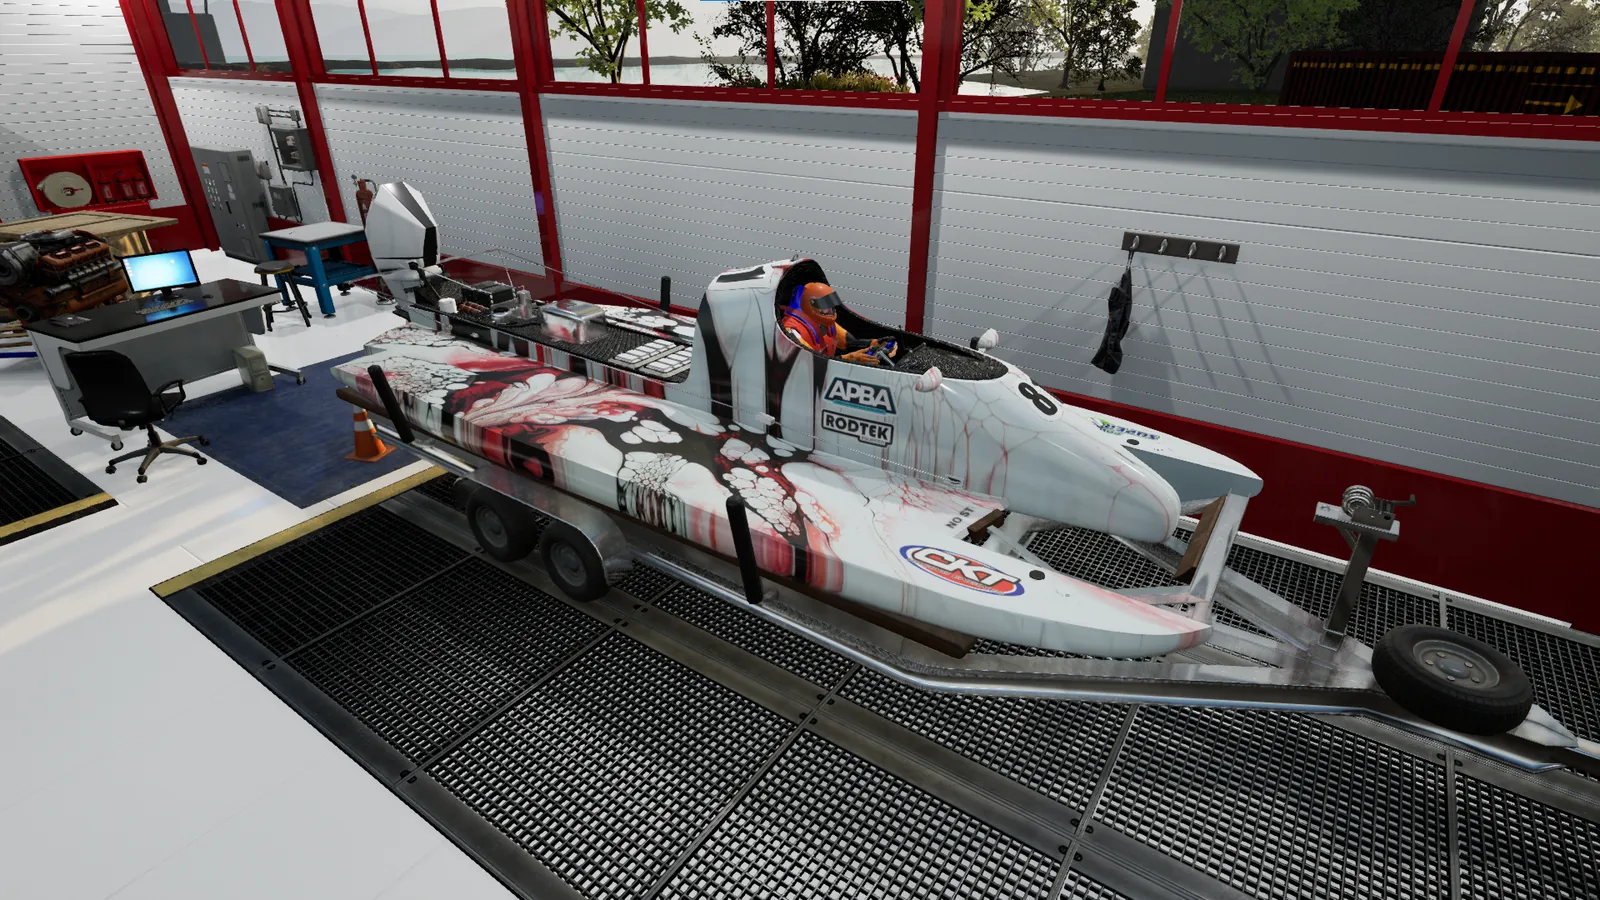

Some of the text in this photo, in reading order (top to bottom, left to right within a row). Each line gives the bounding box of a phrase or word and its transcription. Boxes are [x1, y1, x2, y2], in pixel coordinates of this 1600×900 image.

[828, 379, 893, 412] APBA
[825, 414, 889, 441] RODTEK
[946, 516, 962, 529] NO
[911, 546, 1021, 587] CKT
